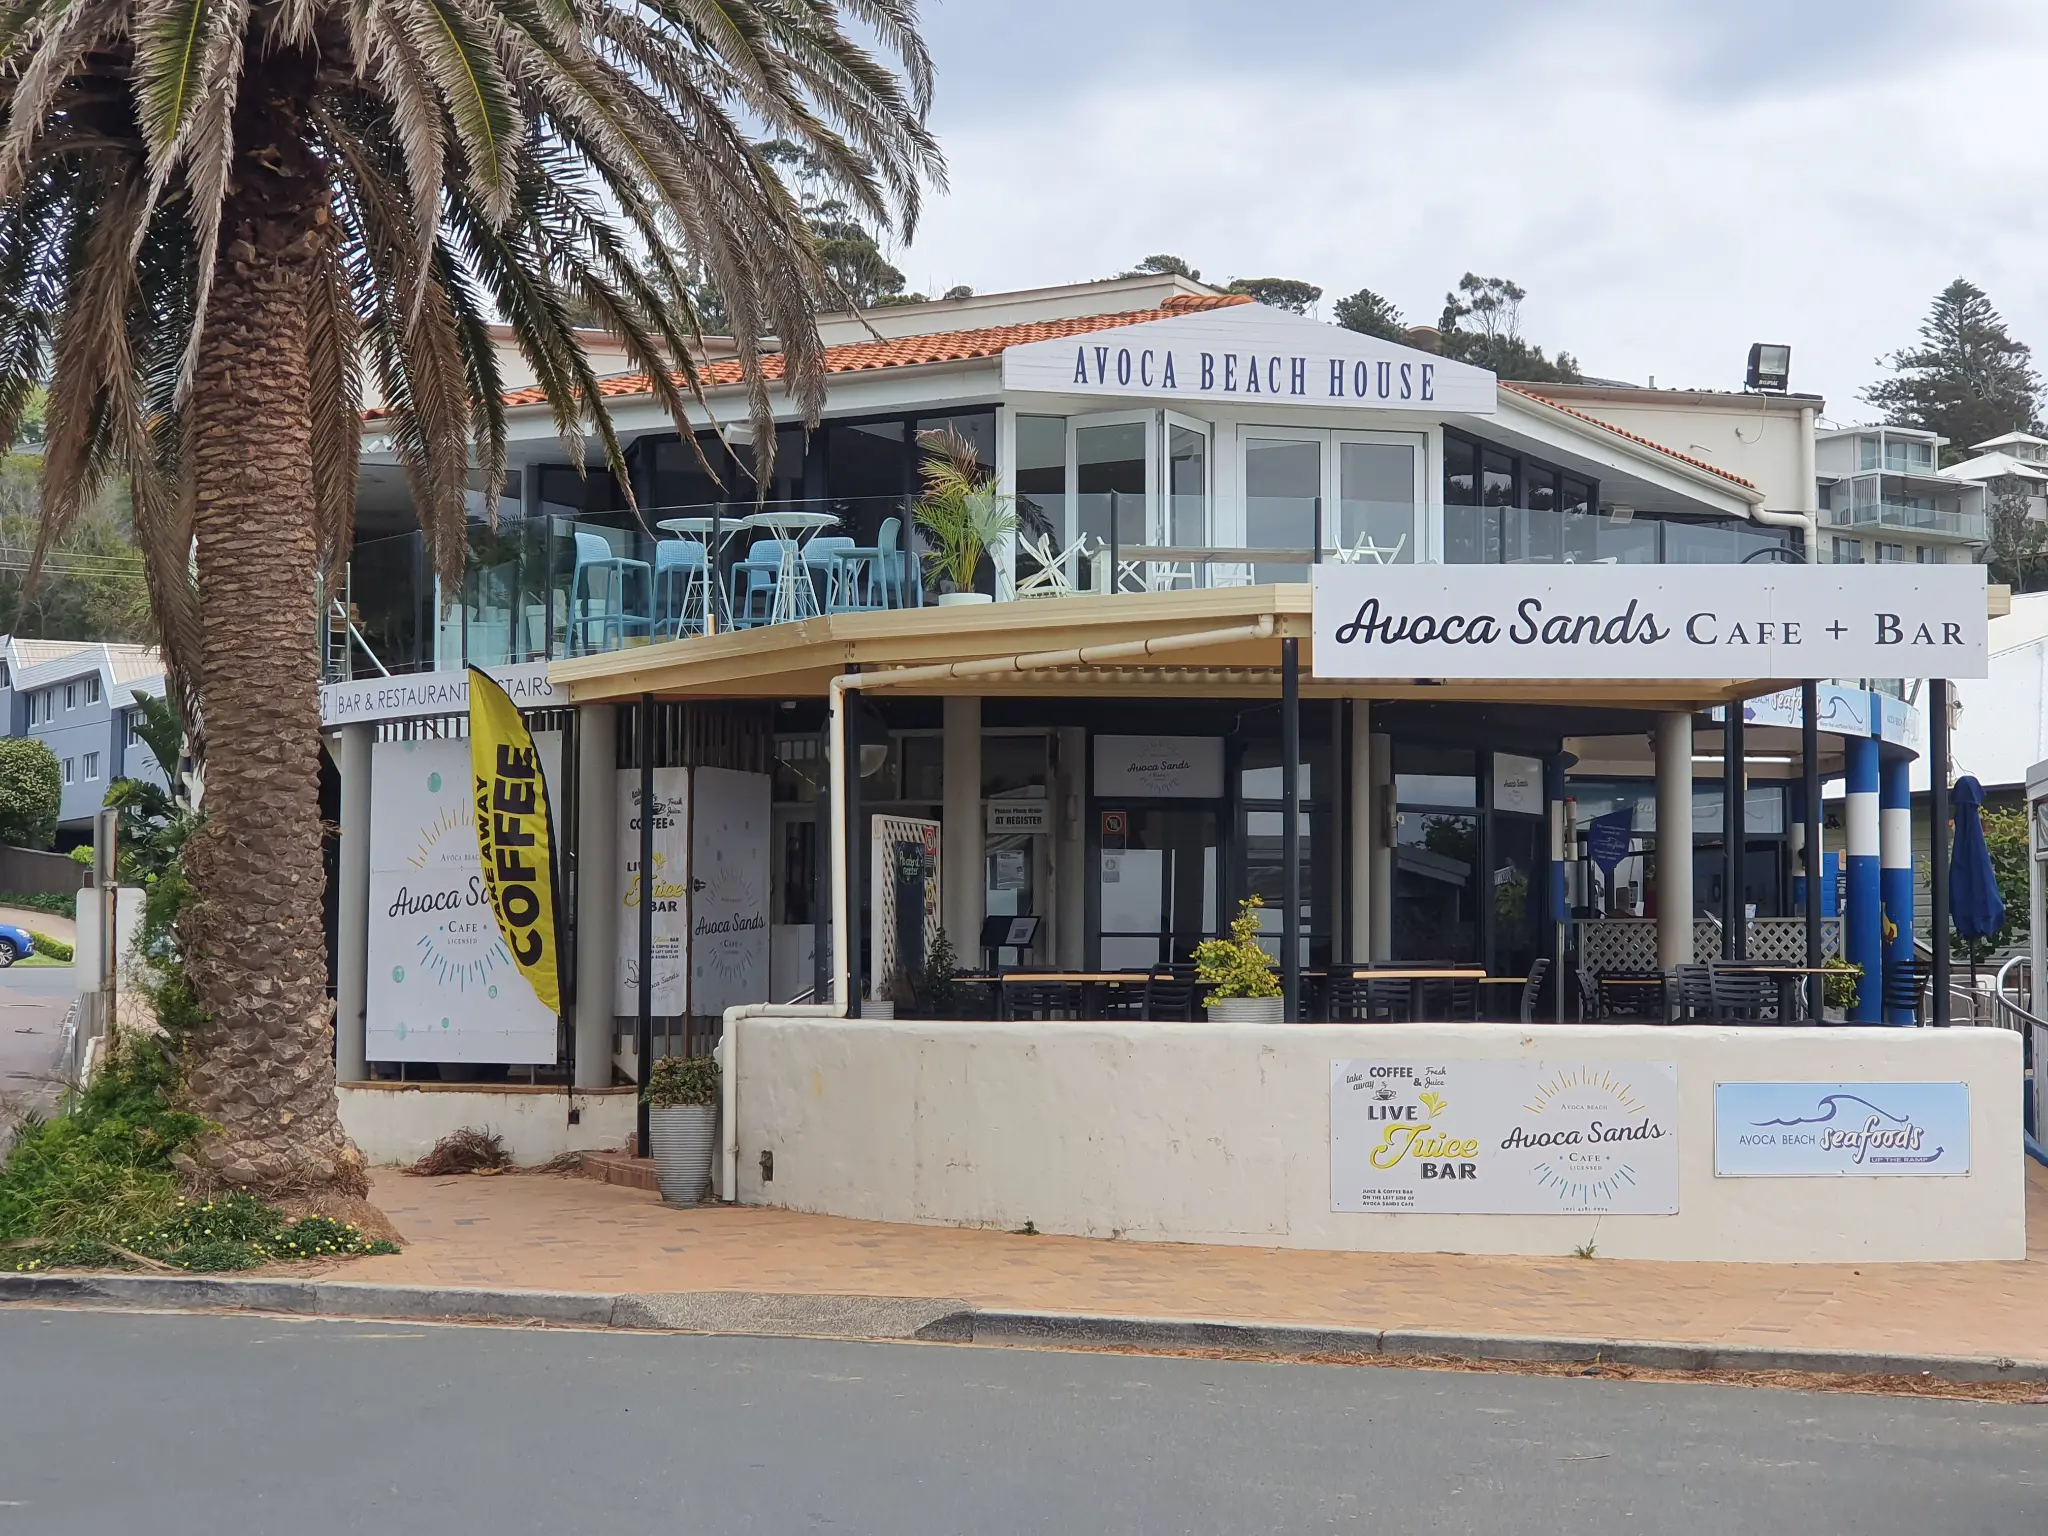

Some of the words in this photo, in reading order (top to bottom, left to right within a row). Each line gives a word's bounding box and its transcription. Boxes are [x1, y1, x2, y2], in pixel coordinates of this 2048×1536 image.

[1073, 346, 1178, 388] AVOCA
[1200, 352, 1307, 396] BEACH
[1329, 359, 1436, 401] HOUSE
[1334, 597, 1502, 645] Avoca
[1508, 597, 1670, 645] Sands
[337, 694, 361, 714] BAR
[364, 691, 374, 711] &
[377, 682, 469, 709] RESTAURANT
[497, 676, 553, 698] TAIRS
[1126, 763, 1160, 773] Avoca
[1160, 759, 1192, 771] Sands
[476, 774, 493, 862] AWAY
[995, 816, 1005, 825] AT
[1006, 816, 1042, 825] REGISTER
[464, 854, 482, 862] BEAC
[493, 744, 543, 967] COFFEE
[389, 886, 462, 917] Avoca
[695, 915, 730, 936] Avoca
[732, 911, 765, 932] Sands
[1346, 1073, 1363, 1084] take
[1369, 1066, 1413, 1078] COFFEE
[1425, 1066, 1447, 1076] Fresh
[1353, 1079, 1374, 1091] away
[1413, 1077, 1422, 1087] &
[1424, 1076, 1445, 1088] Juice
[1367, 1105, 1418, 1121] LIVE
[1500, 1126, 1583, 1150] Avoca
[1587, 1117, 1666, 1143] Sands
[1739, 1134, 1777, 1146] AVOCA
[1782, 1134, 1816, 1146] BEACH
[1819, 1115, 1925, 1164] seafoods
[1369, 1123, 1479, 1170] Juice
[1420, 1162, 1478, 1180] BAR
